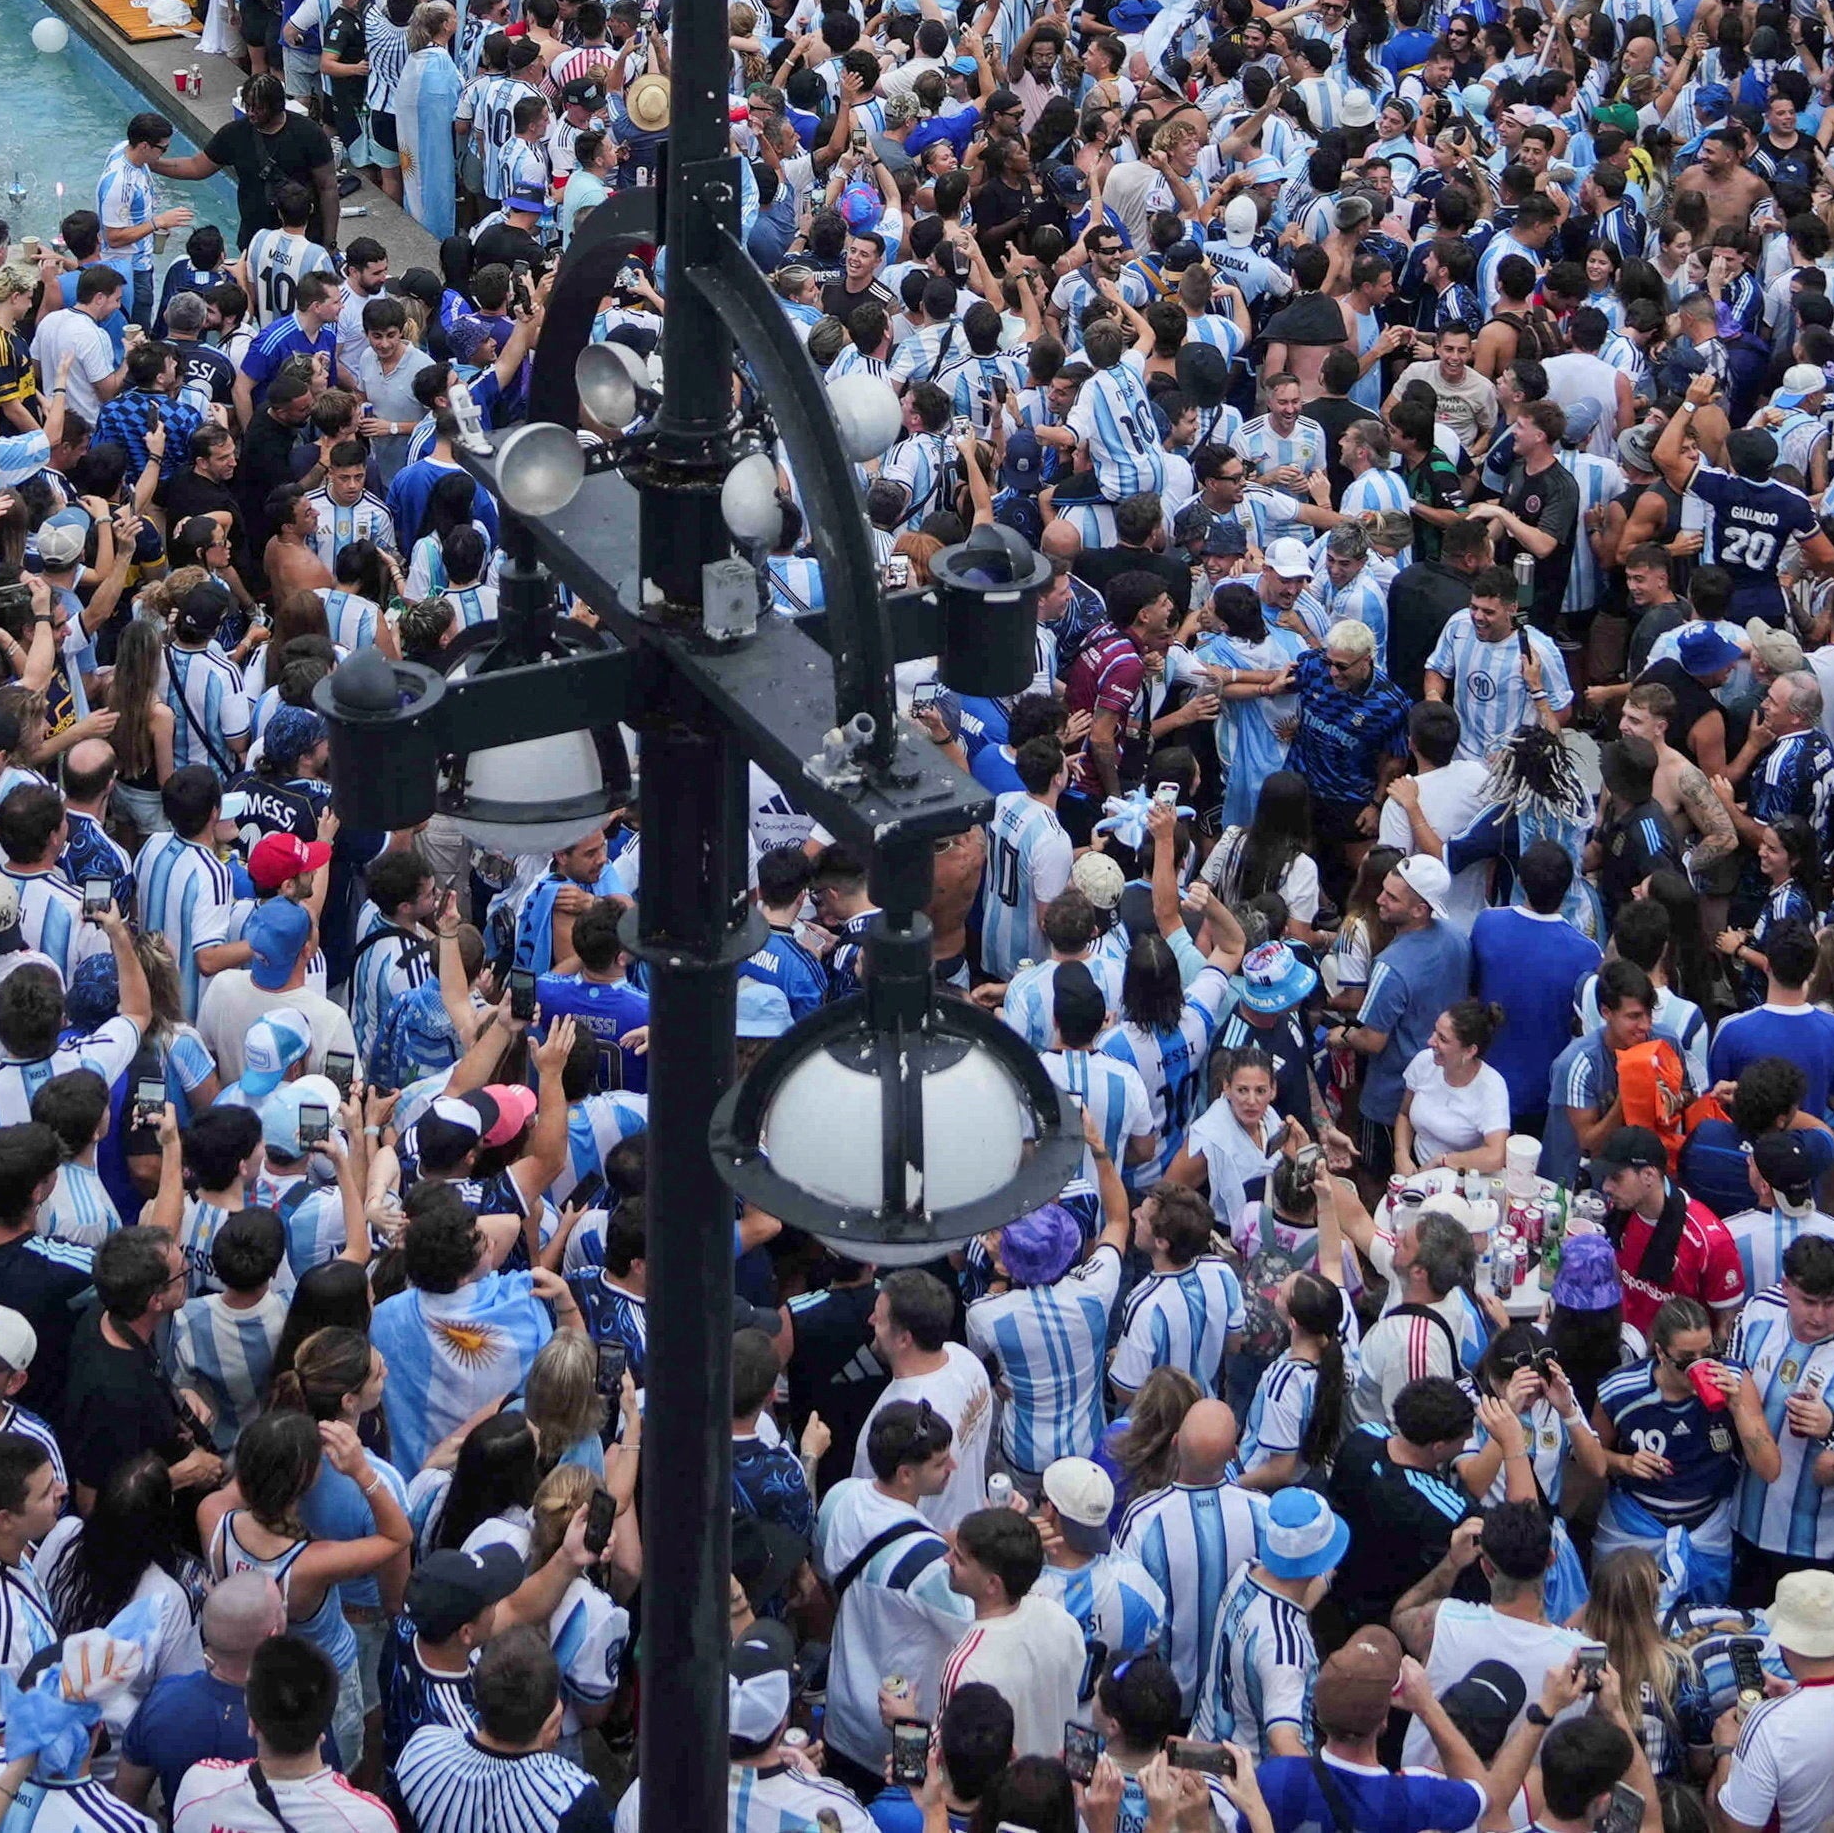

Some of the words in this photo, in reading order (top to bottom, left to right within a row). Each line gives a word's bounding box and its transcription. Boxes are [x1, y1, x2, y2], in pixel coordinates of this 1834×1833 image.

[487, 102, 514, 148] 10
[266, 249, 292, 267] MESSI
[259, 265, 296, 318] 10
[1722, 526, 1778, 572] 20
[243, 790, 298, 830] MESSI
[987, 830, 1019, 909] 10
[1156, 1041, 1197, 1073] MESSI
